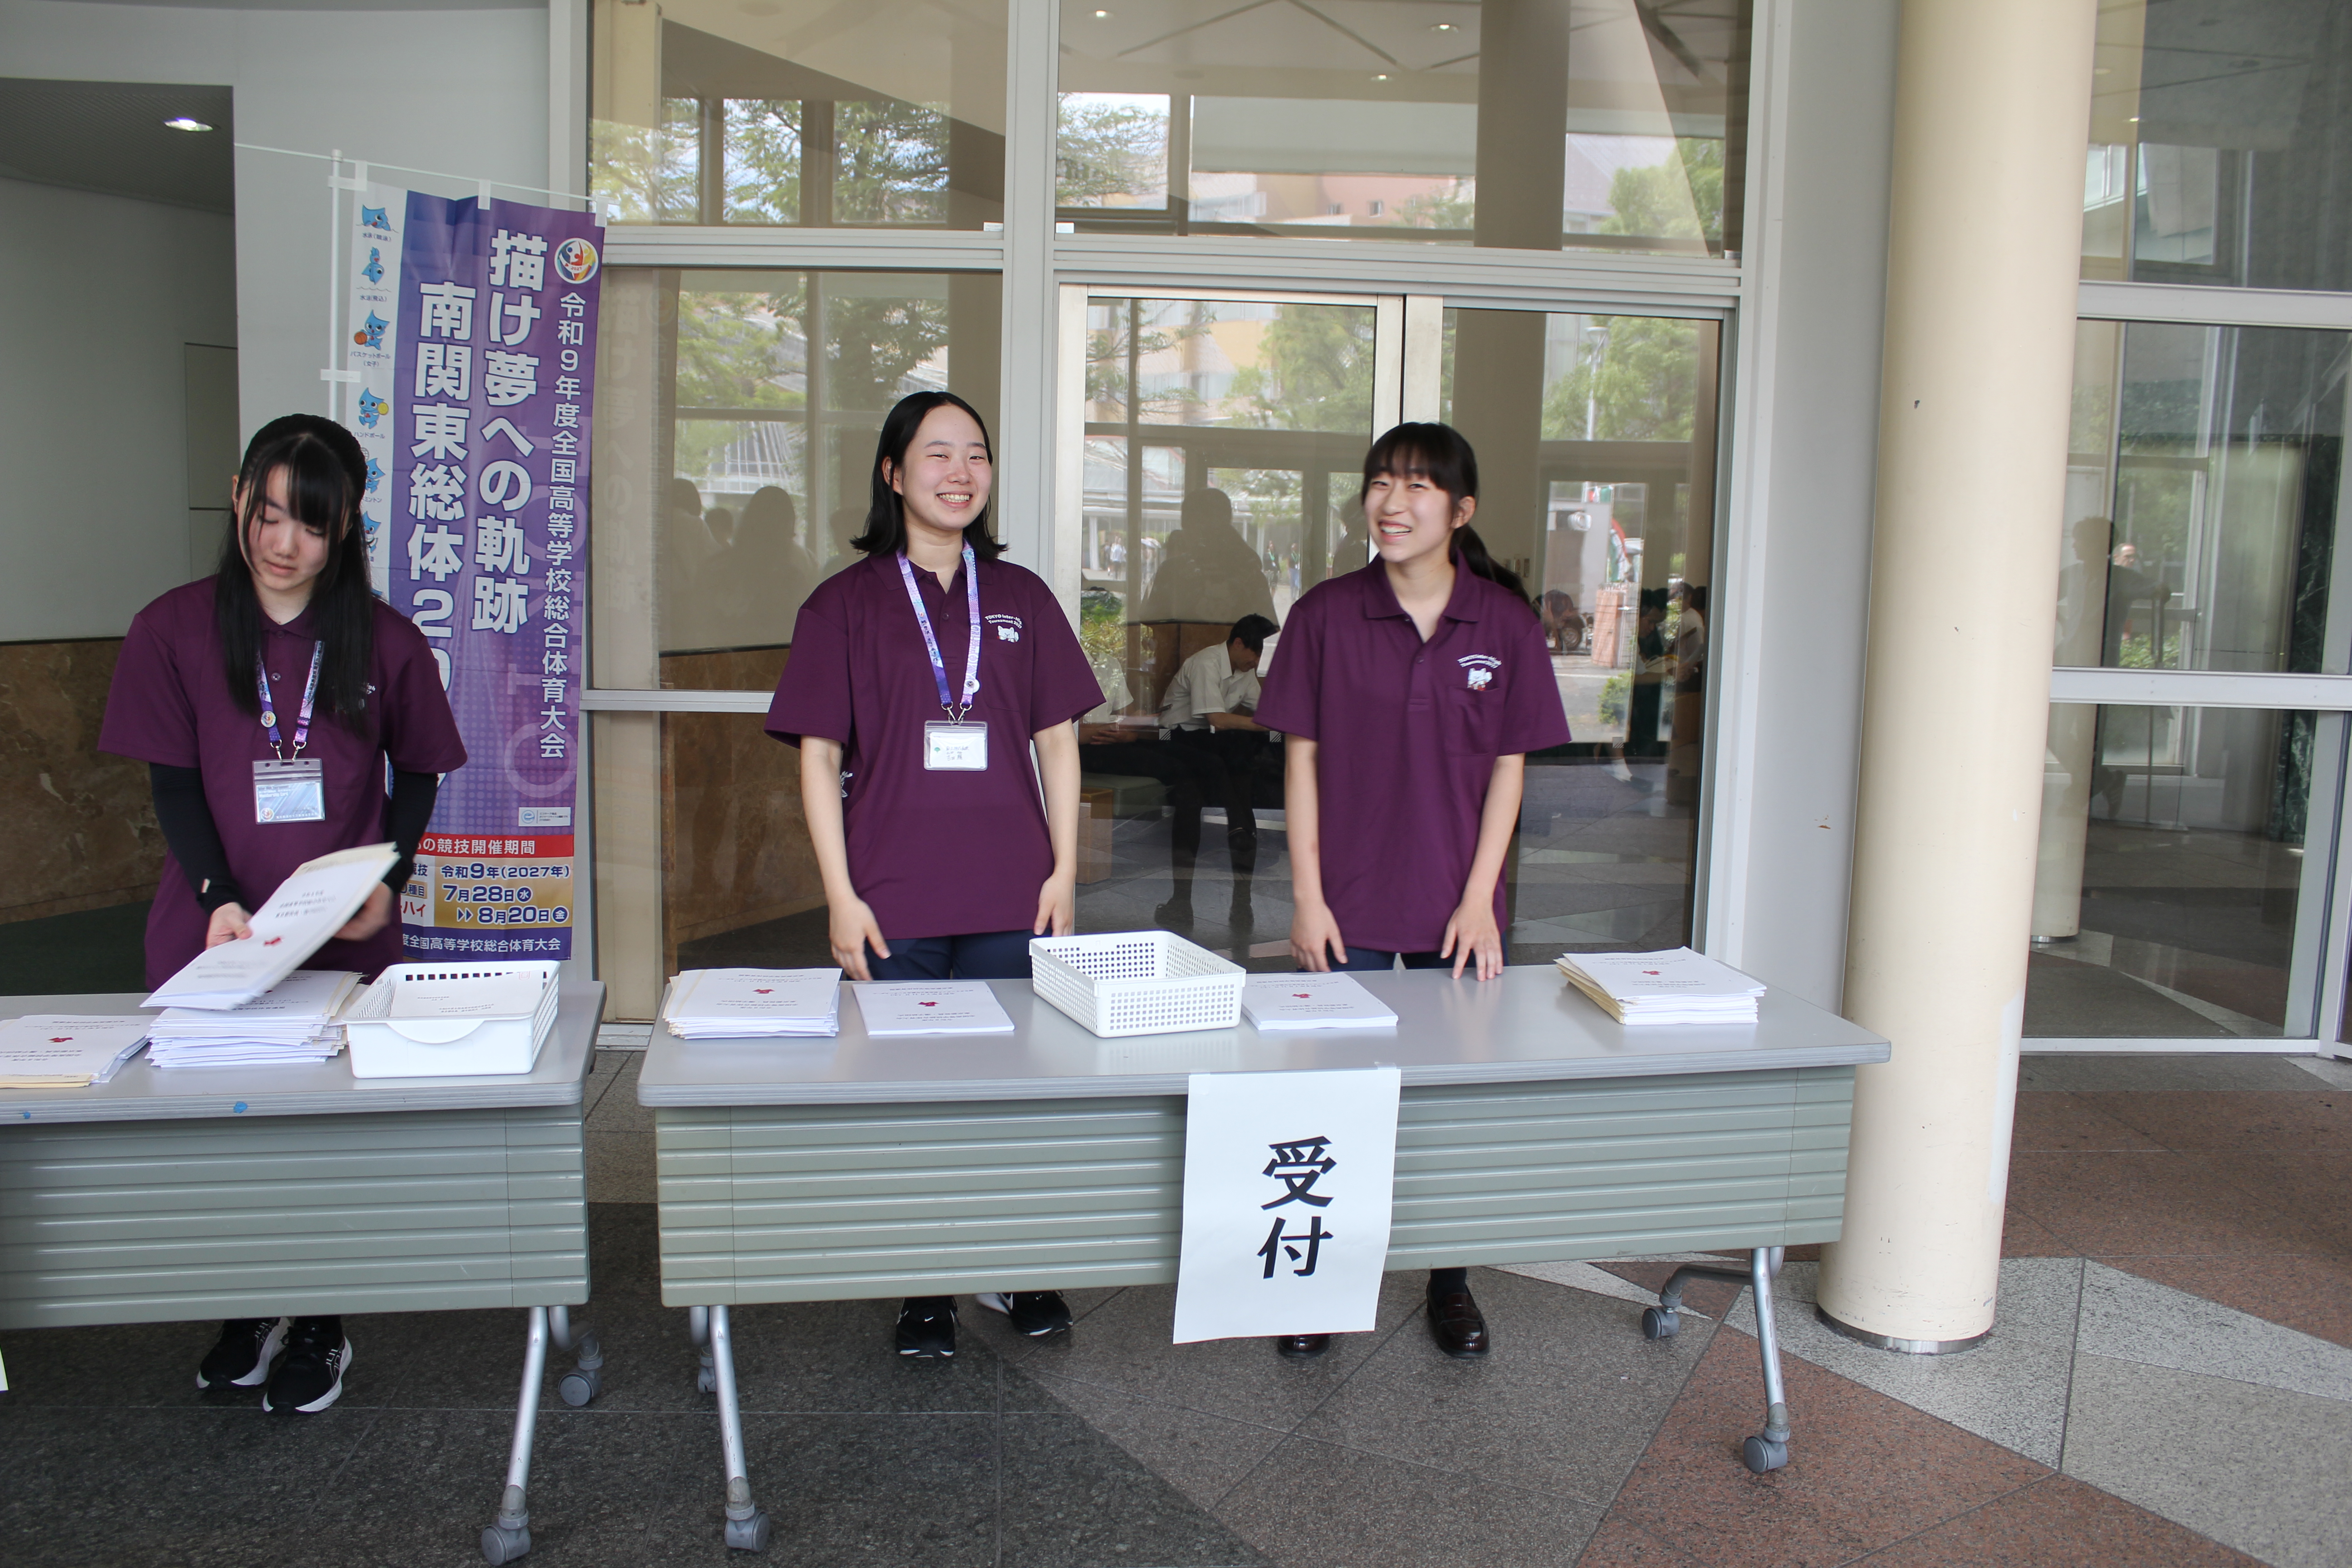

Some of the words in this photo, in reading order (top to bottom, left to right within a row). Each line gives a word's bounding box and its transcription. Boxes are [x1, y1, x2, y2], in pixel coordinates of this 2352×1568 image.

[350, 351, 391, 359] バスケットボール
[472, 228, 548, 634] 描け夢への軌跡
[407, 281, 476, 788] 南関東総体2
[539, 291, 586, 759] 令和9年度全国高等学校総合体育大会
[400, 901, 426, 917] ハイ
[418, 838, 535, 855] の競技開催期間
[1256, 1136, 1338, 1280] 受付
